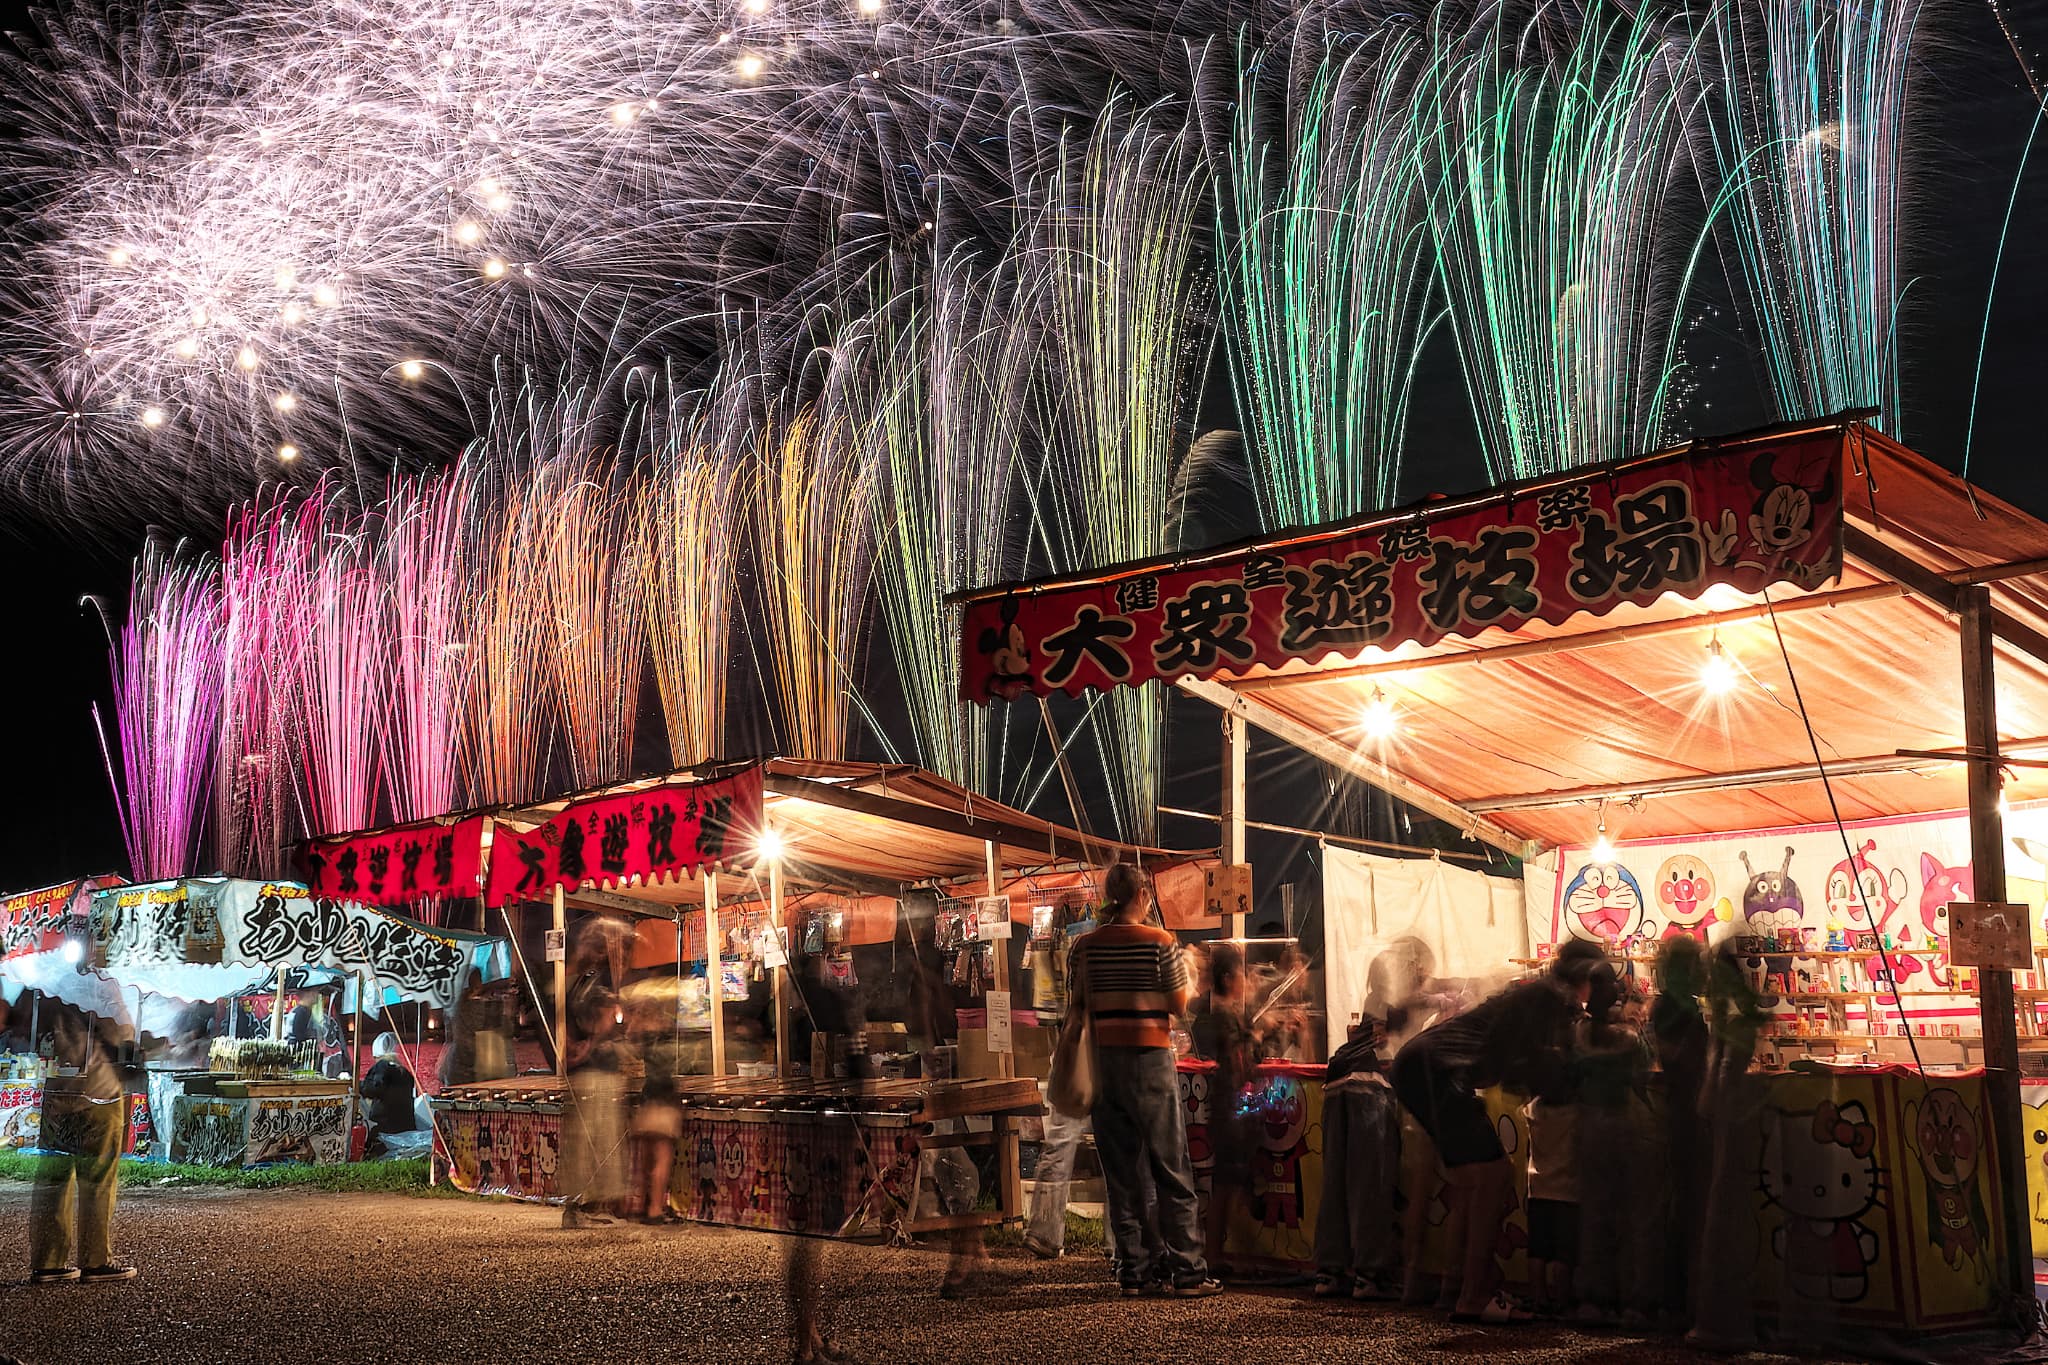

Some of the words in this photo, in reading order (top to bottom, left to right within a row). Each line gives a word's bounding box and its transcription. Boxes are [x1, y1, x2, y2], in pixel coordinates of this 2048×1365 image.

[1041, 482, 1703, 683] 大衆遊技場
